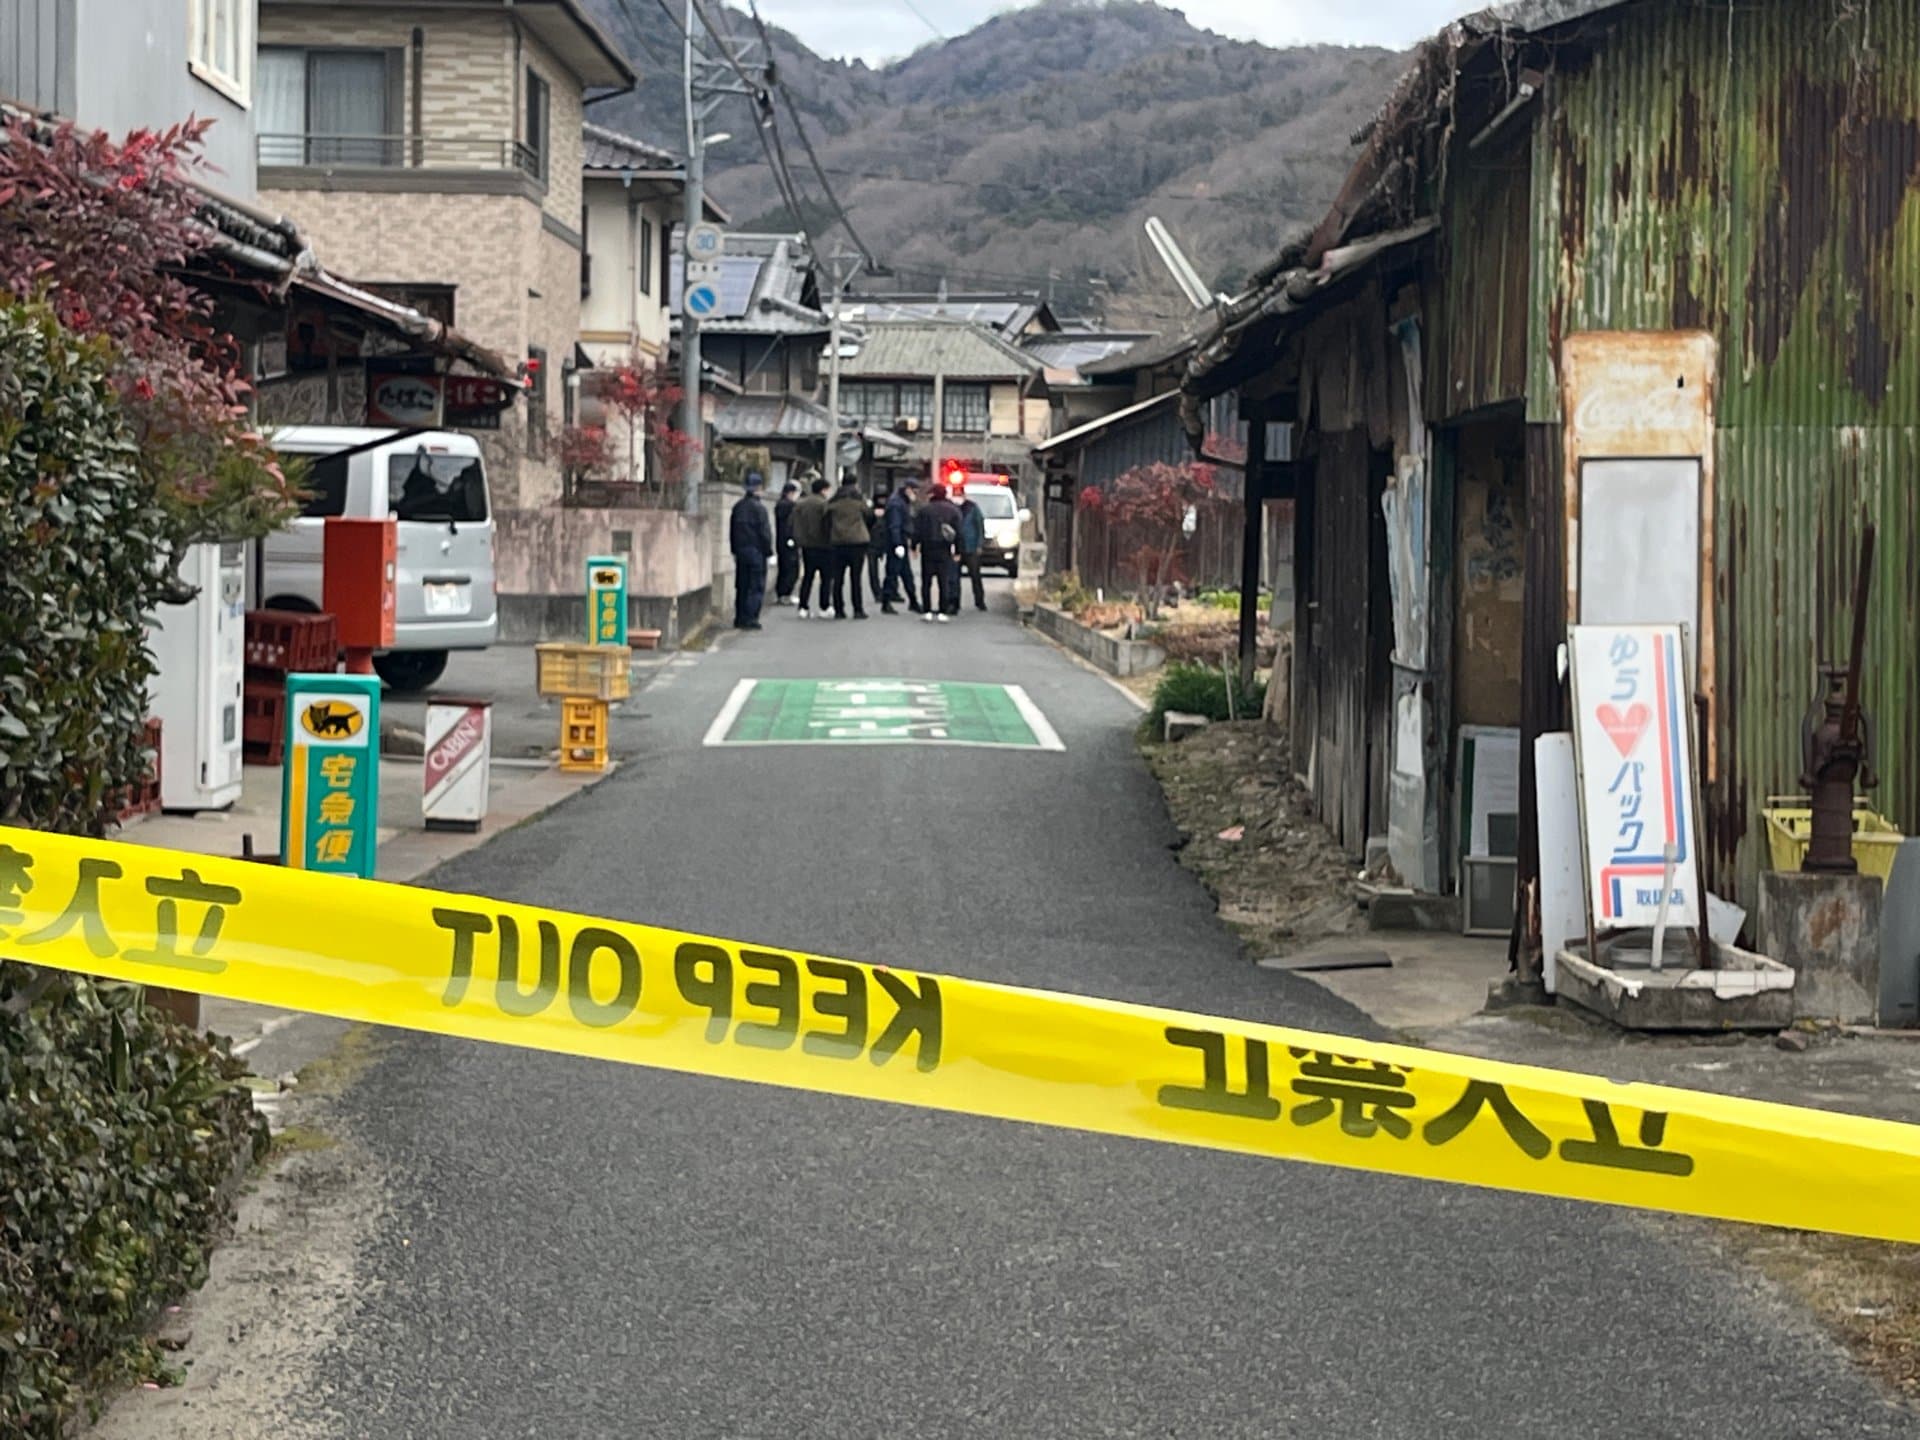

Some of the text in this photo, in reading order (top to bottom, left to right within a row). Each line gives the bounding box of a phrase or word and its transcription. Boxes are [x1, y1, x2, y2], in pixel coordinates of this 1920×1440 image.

[1610, 634, 1640, 700] ゆう
[429, 713, 479, 772] CABIN
[316, 753, 357, 864] 宅急便
[1608, 761, 1644, 853] パック
